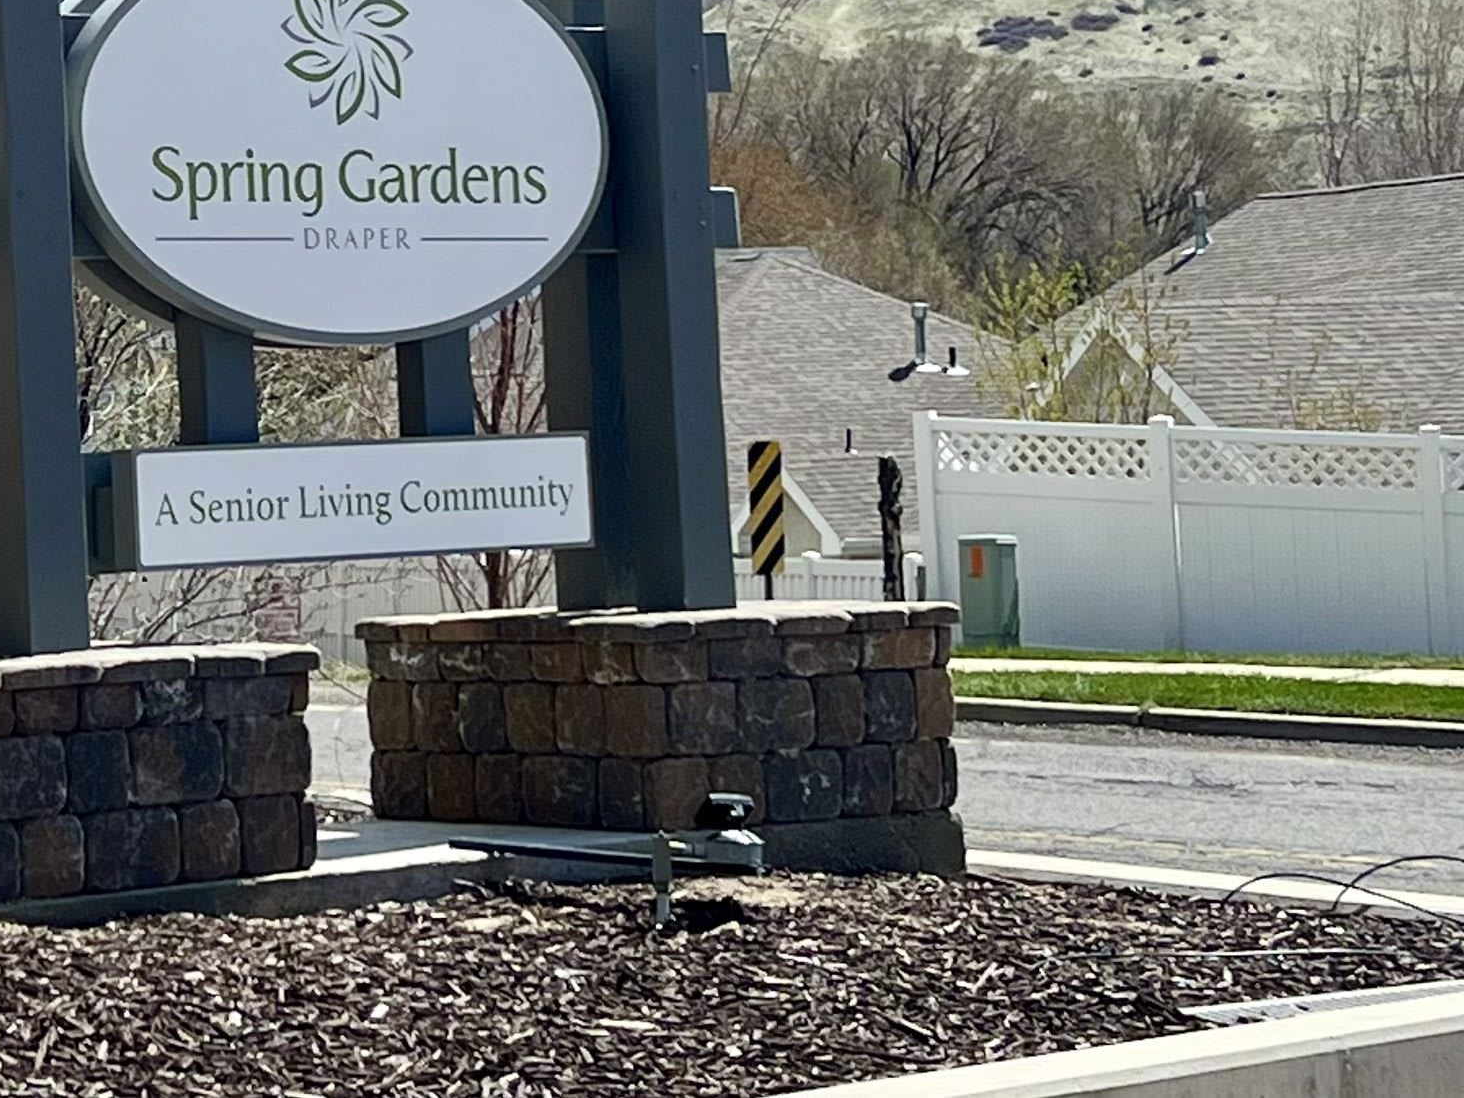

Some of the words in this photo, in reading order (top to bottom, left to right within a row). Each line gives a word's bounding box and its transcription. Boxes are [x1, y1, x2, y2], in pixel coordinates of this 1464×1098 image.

[152, 146, 323, 220] Spring
[338, 147, 547, 204] Gardens
[304, 228, 411, 250] DRAPER
[155, 493, 179, 526] A
[189, 488, 289, 524] Senior
[299, 484, 392, 525] Living
[400, 475, 573, 516] Community
